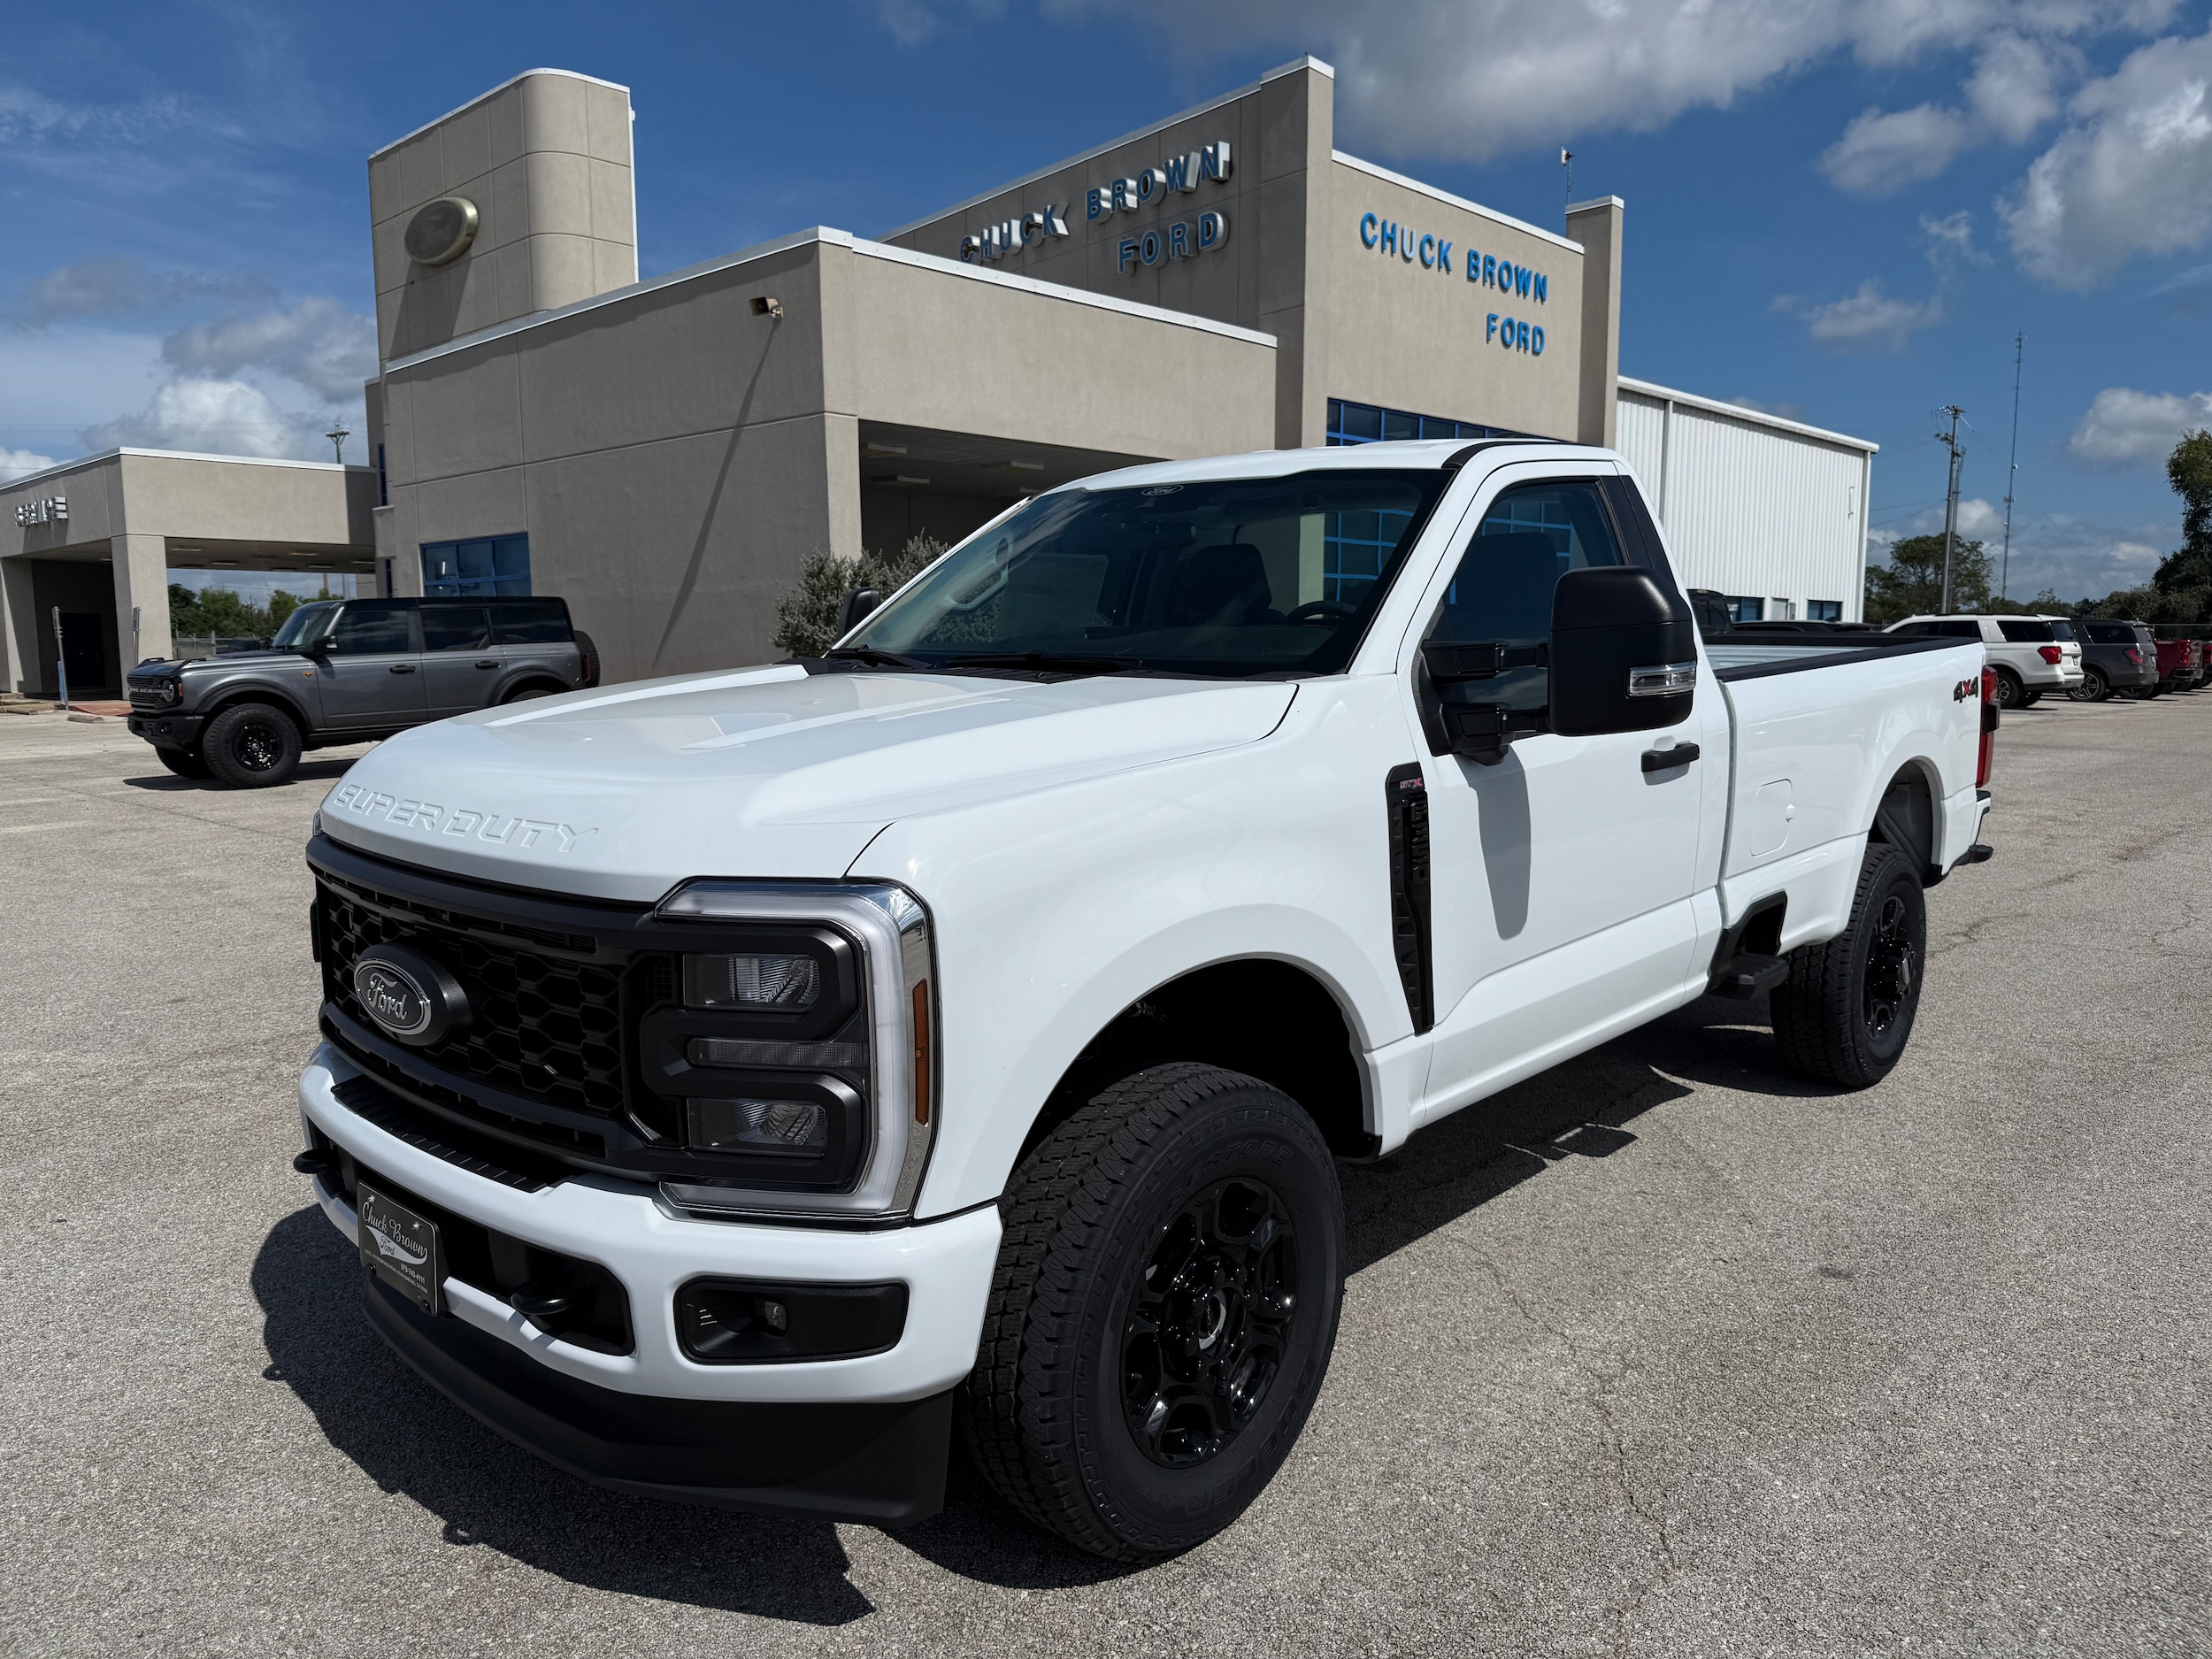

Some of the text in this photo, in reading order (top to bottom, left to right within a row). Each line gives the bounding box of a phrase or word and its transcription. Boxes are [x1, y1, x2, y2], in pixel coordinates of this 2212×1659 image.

[960, 141, 1231, 265] CHUCK BROWN
[1118, 211, 1228, 275] FORD
[1360, 212, 1548, 303] CHUCK BROWN
[1486, 313, 1545, 356] FORD
[1399, 777, 1423, 789] STX
[334, 784, 599, 852] SUPER DUTY
[367, 972, 407, 1020] Ford
[362, 1201, 427, 1257] Chuck Brown
[380, 1235, 396, 1256] Ford
